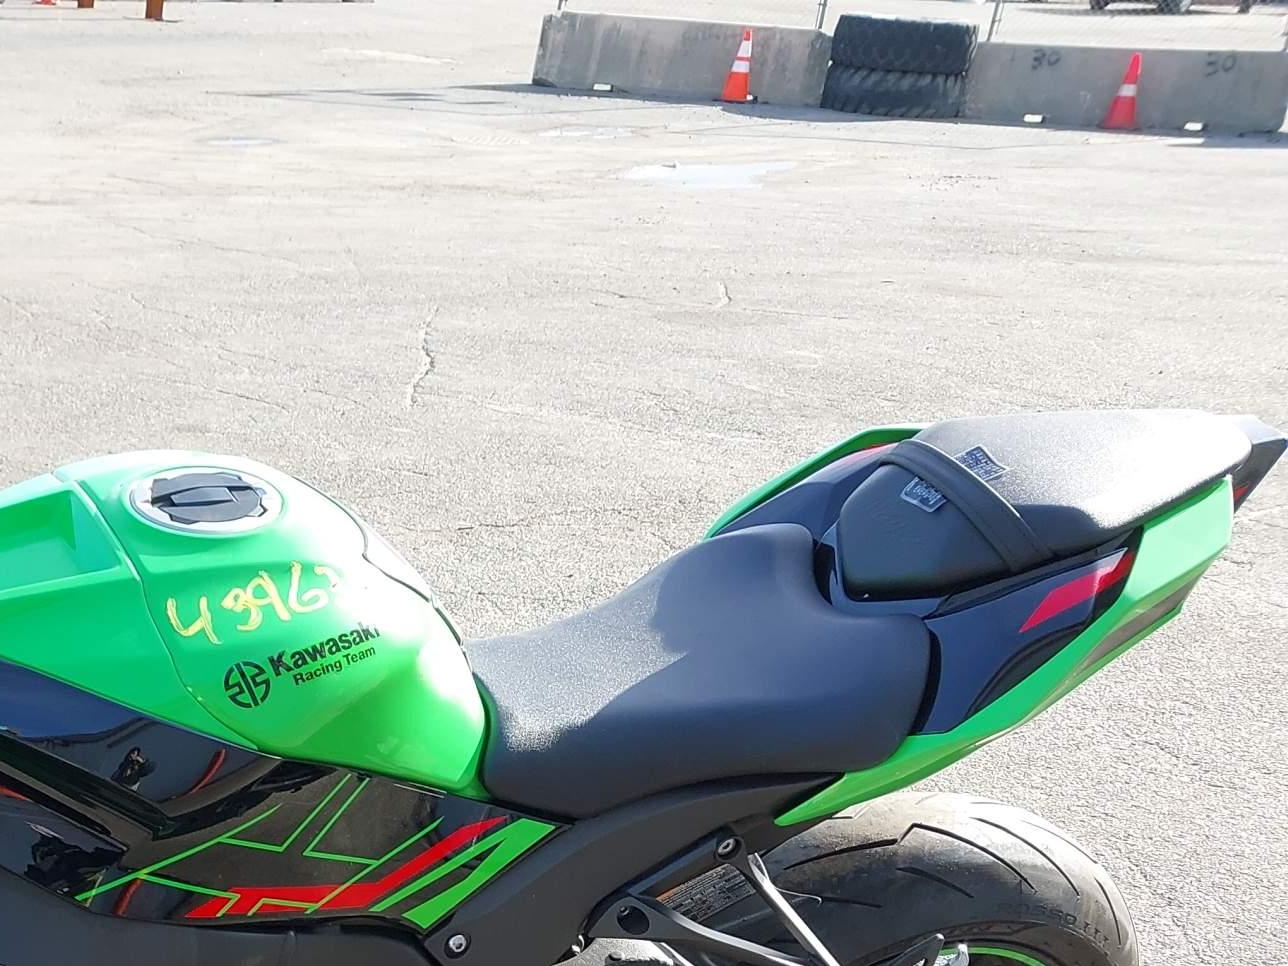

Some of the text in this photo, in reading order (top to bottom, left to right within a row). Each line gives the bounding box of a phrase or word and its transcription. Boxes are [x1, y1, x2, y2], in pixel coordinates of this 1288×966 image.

[268, 621, 380, 677] Kawasaki
[292, 645, 376, 686] Racing Team
